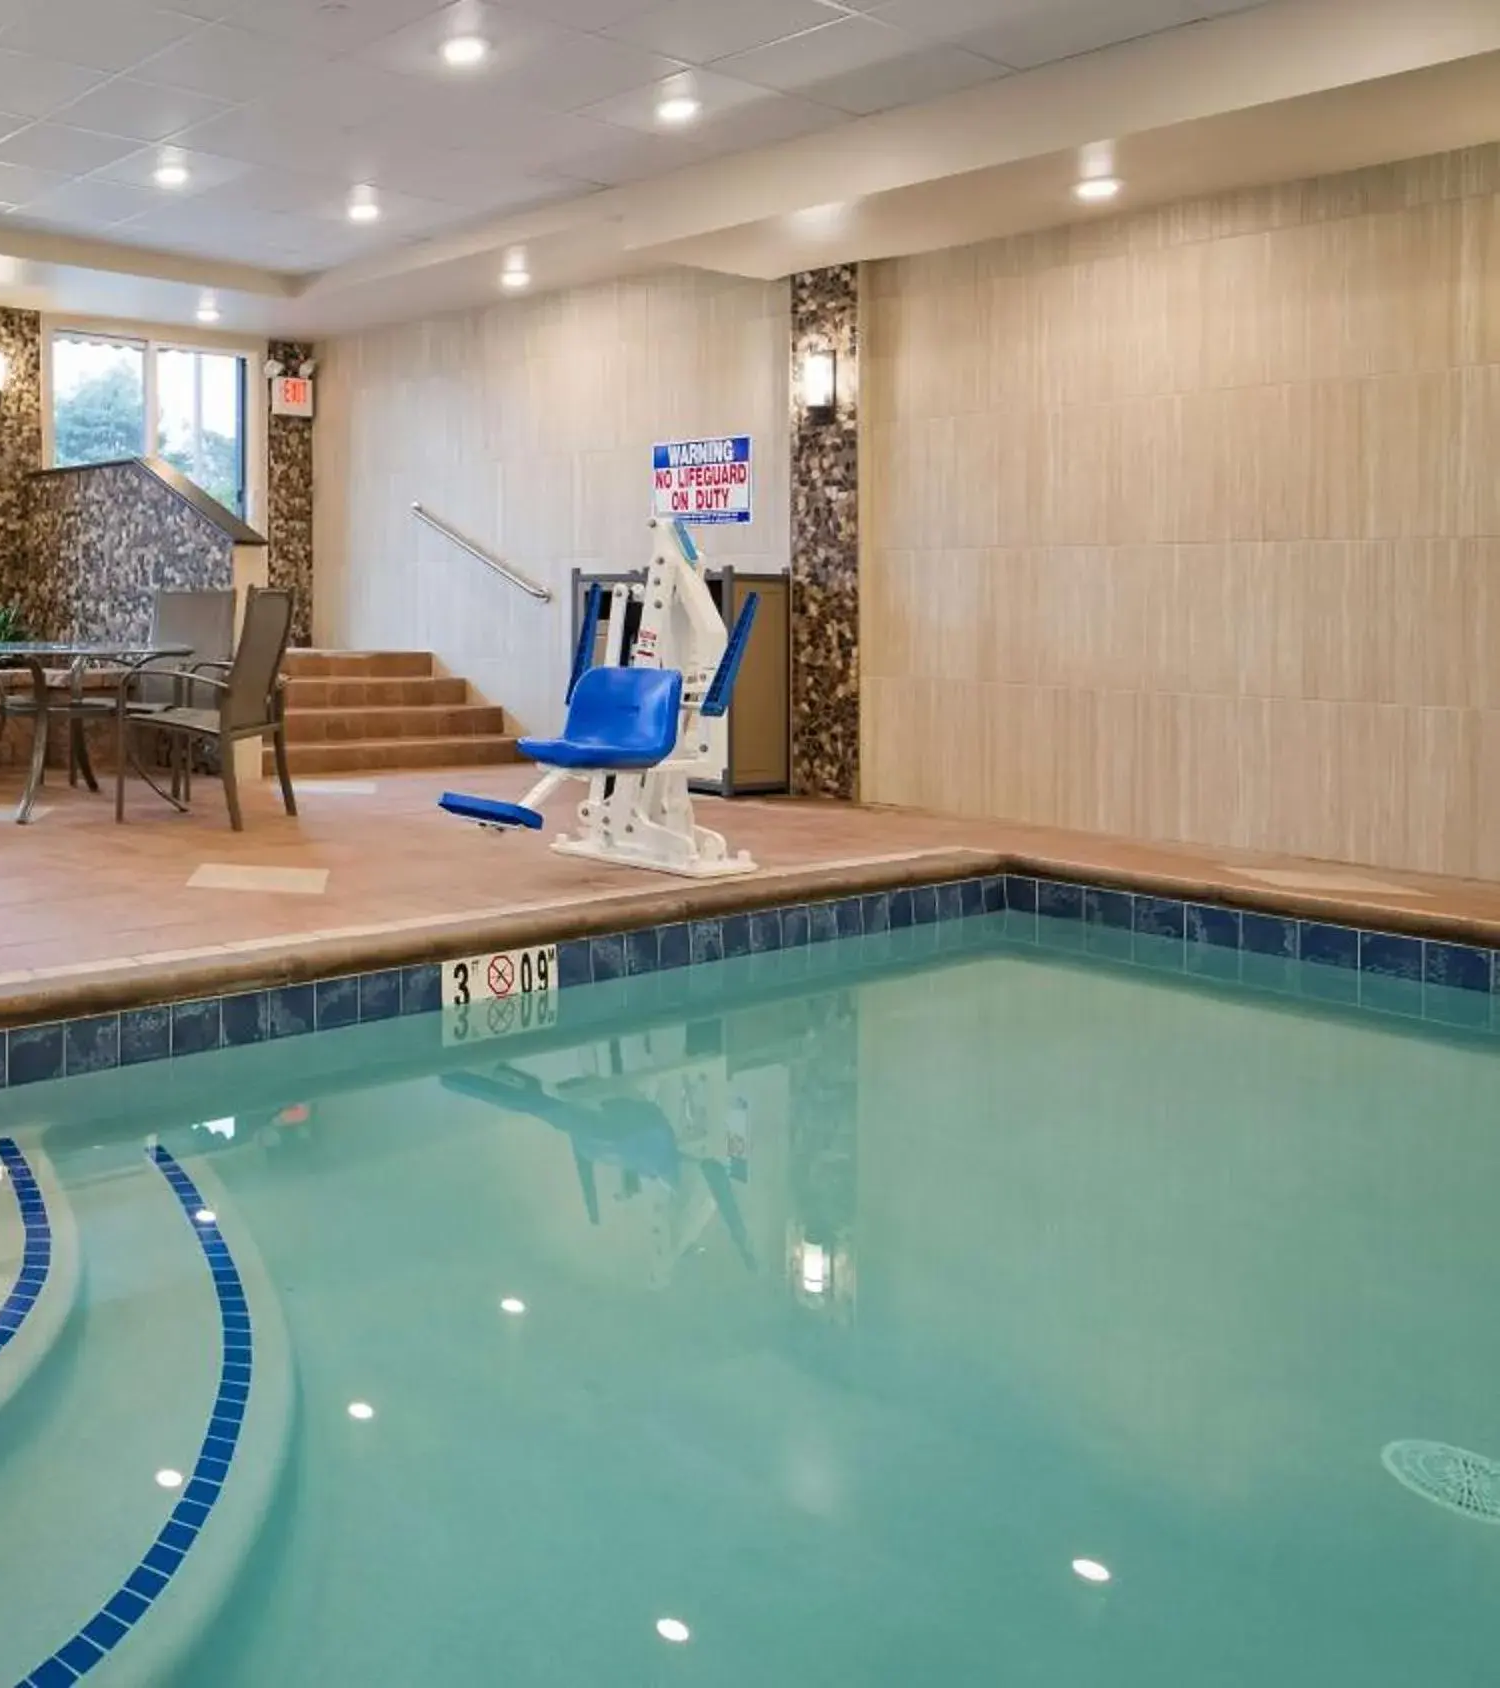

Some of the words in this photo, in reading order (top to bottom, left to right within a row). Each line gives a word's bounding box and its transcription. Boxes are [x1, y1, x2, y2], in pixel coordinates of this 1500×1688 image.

[284, 379, 307, 403] EXIT
[668, 440, 734, 466] WARNING
[655, 469, 672, 488] NO
[678, 464, 746, 488] LIFEGUARD
[671, 490, 689, 510] ON
[695, 487, 730, 509] DUTY
[453, 963, 470, 1005] 3
